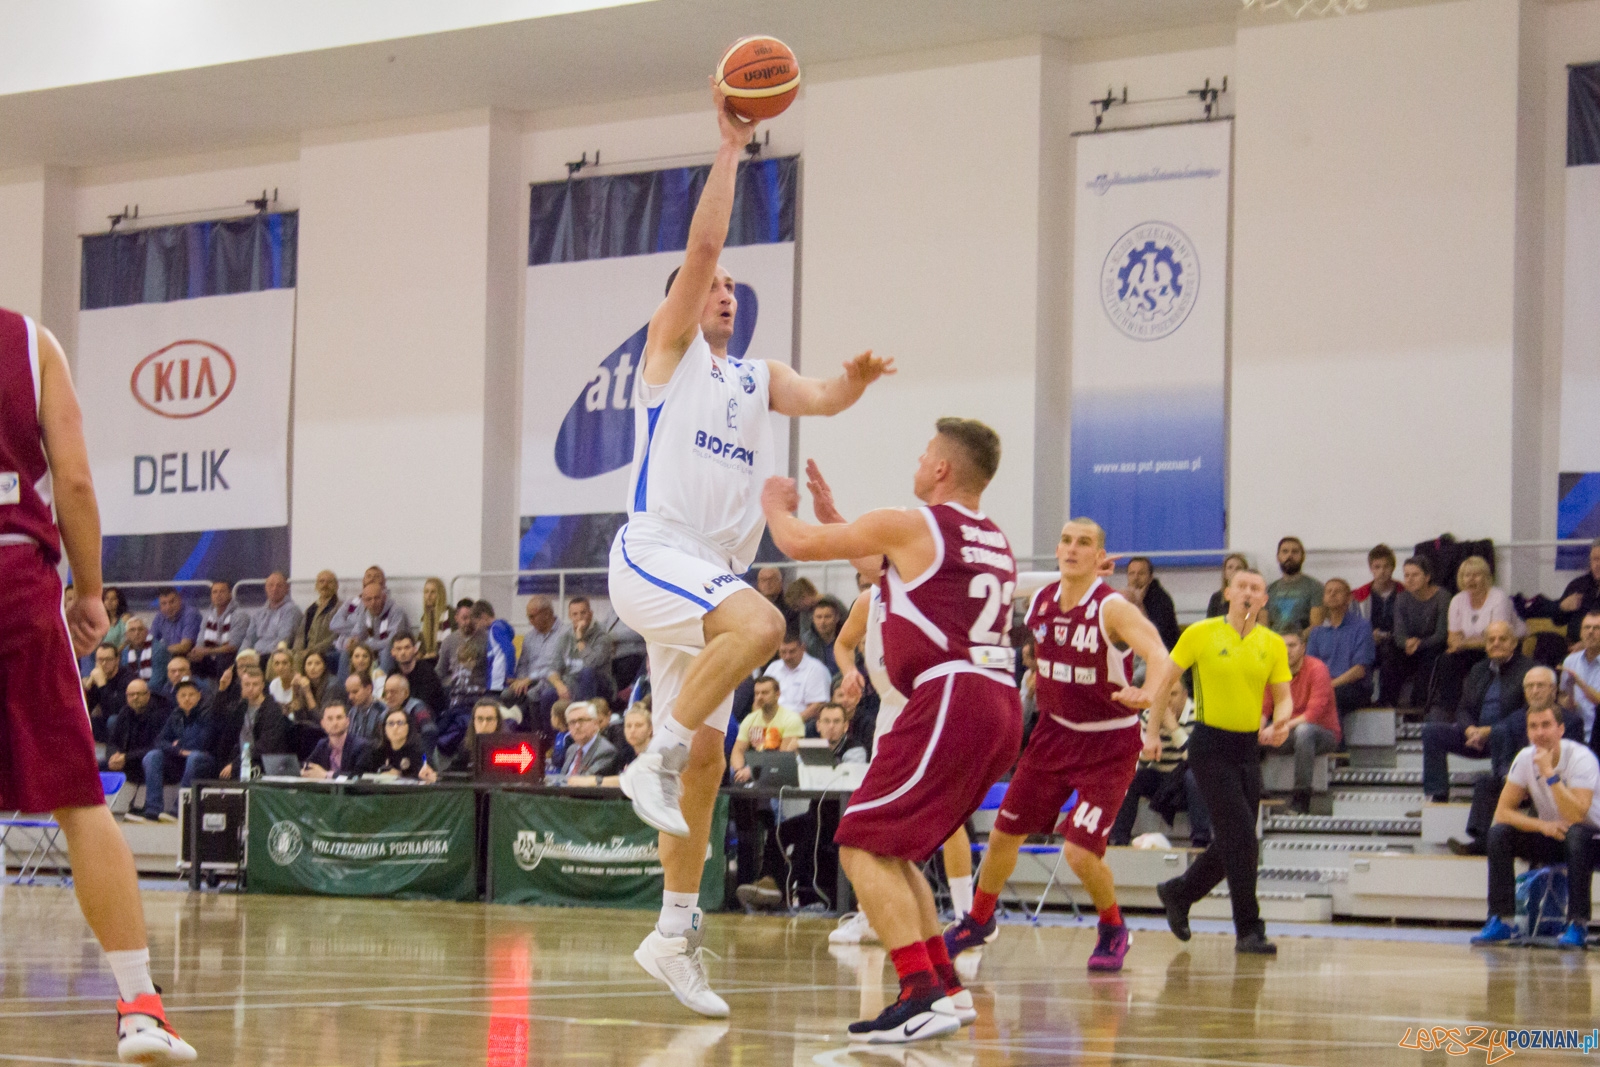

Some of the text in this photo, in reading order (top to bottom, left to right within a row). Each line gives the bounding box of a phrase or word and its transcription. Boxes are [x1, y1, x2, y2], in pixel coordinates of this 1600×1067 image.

[743, 63, 790, 83] molten
[153, 356, 217, 403] KIA
[133, 448, 230, 496] DELIK
[1070, 623, 1099, 654] 44
[1073, 801, 1103, 834] 44
[312, 838, 449, 856] POLITECHNIKA POZNAŃSKA
